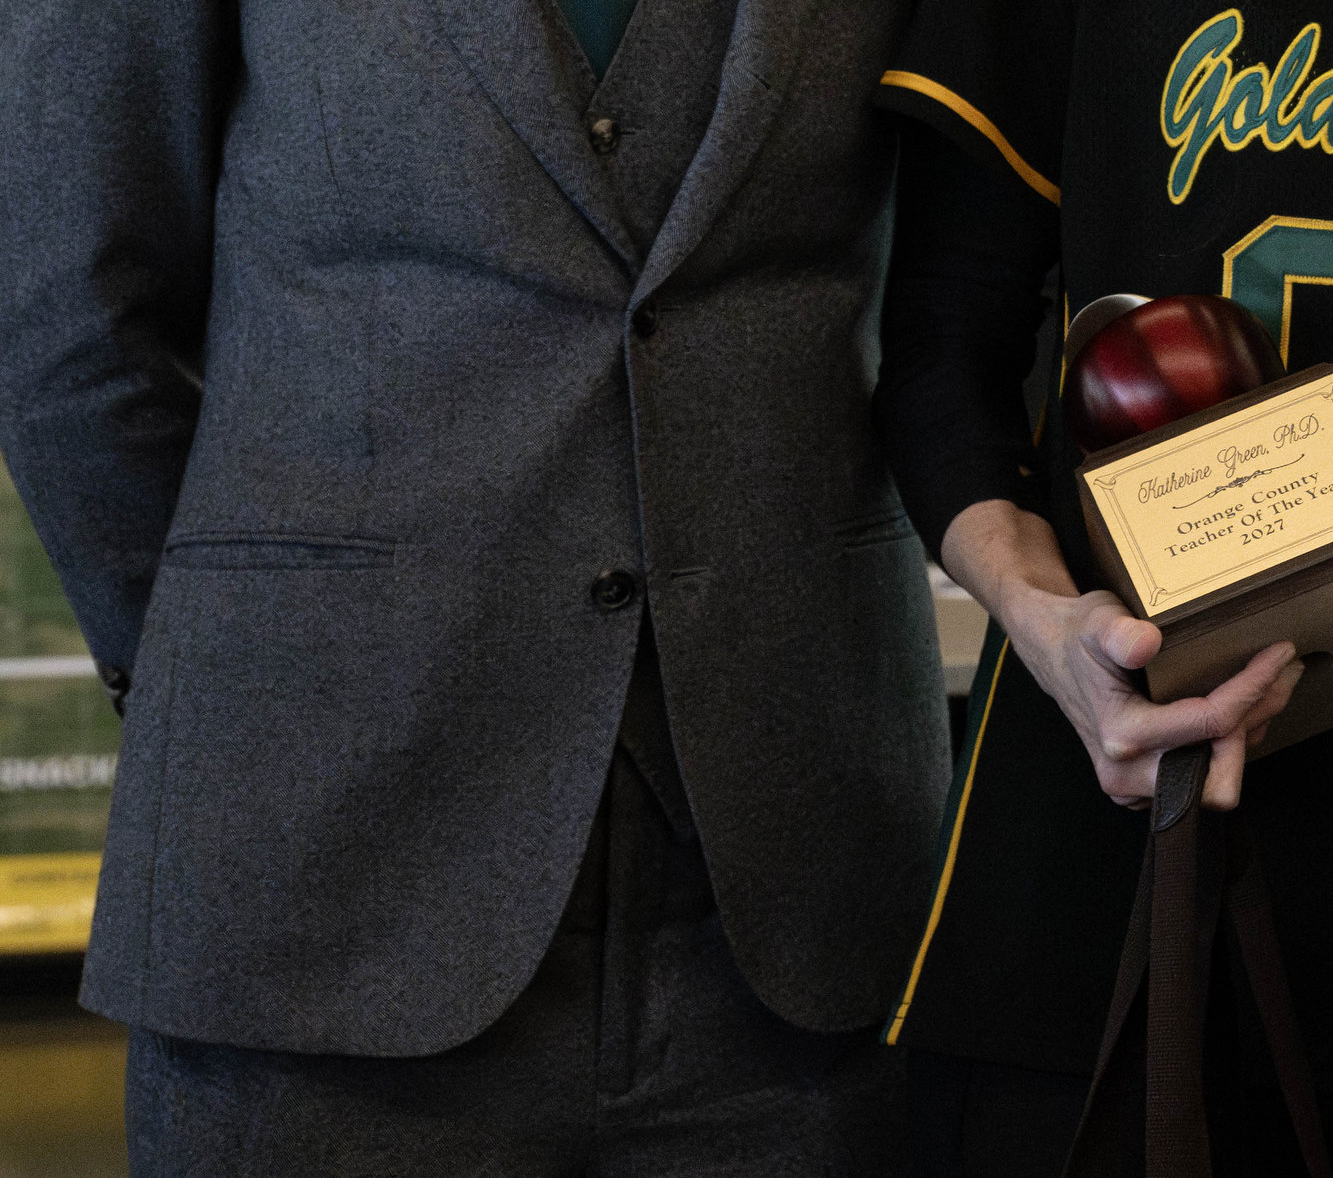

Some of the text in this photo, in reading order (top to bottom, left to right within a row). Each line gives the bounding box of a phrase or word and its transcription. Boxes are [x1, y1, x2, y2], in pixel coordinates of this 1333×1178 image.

[1137, 413, 1325, 504] Katherine Green, Ph.D.
[1164, 525, 1234, 558] Teacher
[1240, 510, 1262, 527] Of
[1267, 496, 1304, 516] The
[1176, 472, 1320, 535] Orange County
[1239, 518, 1285, 546] 2027
